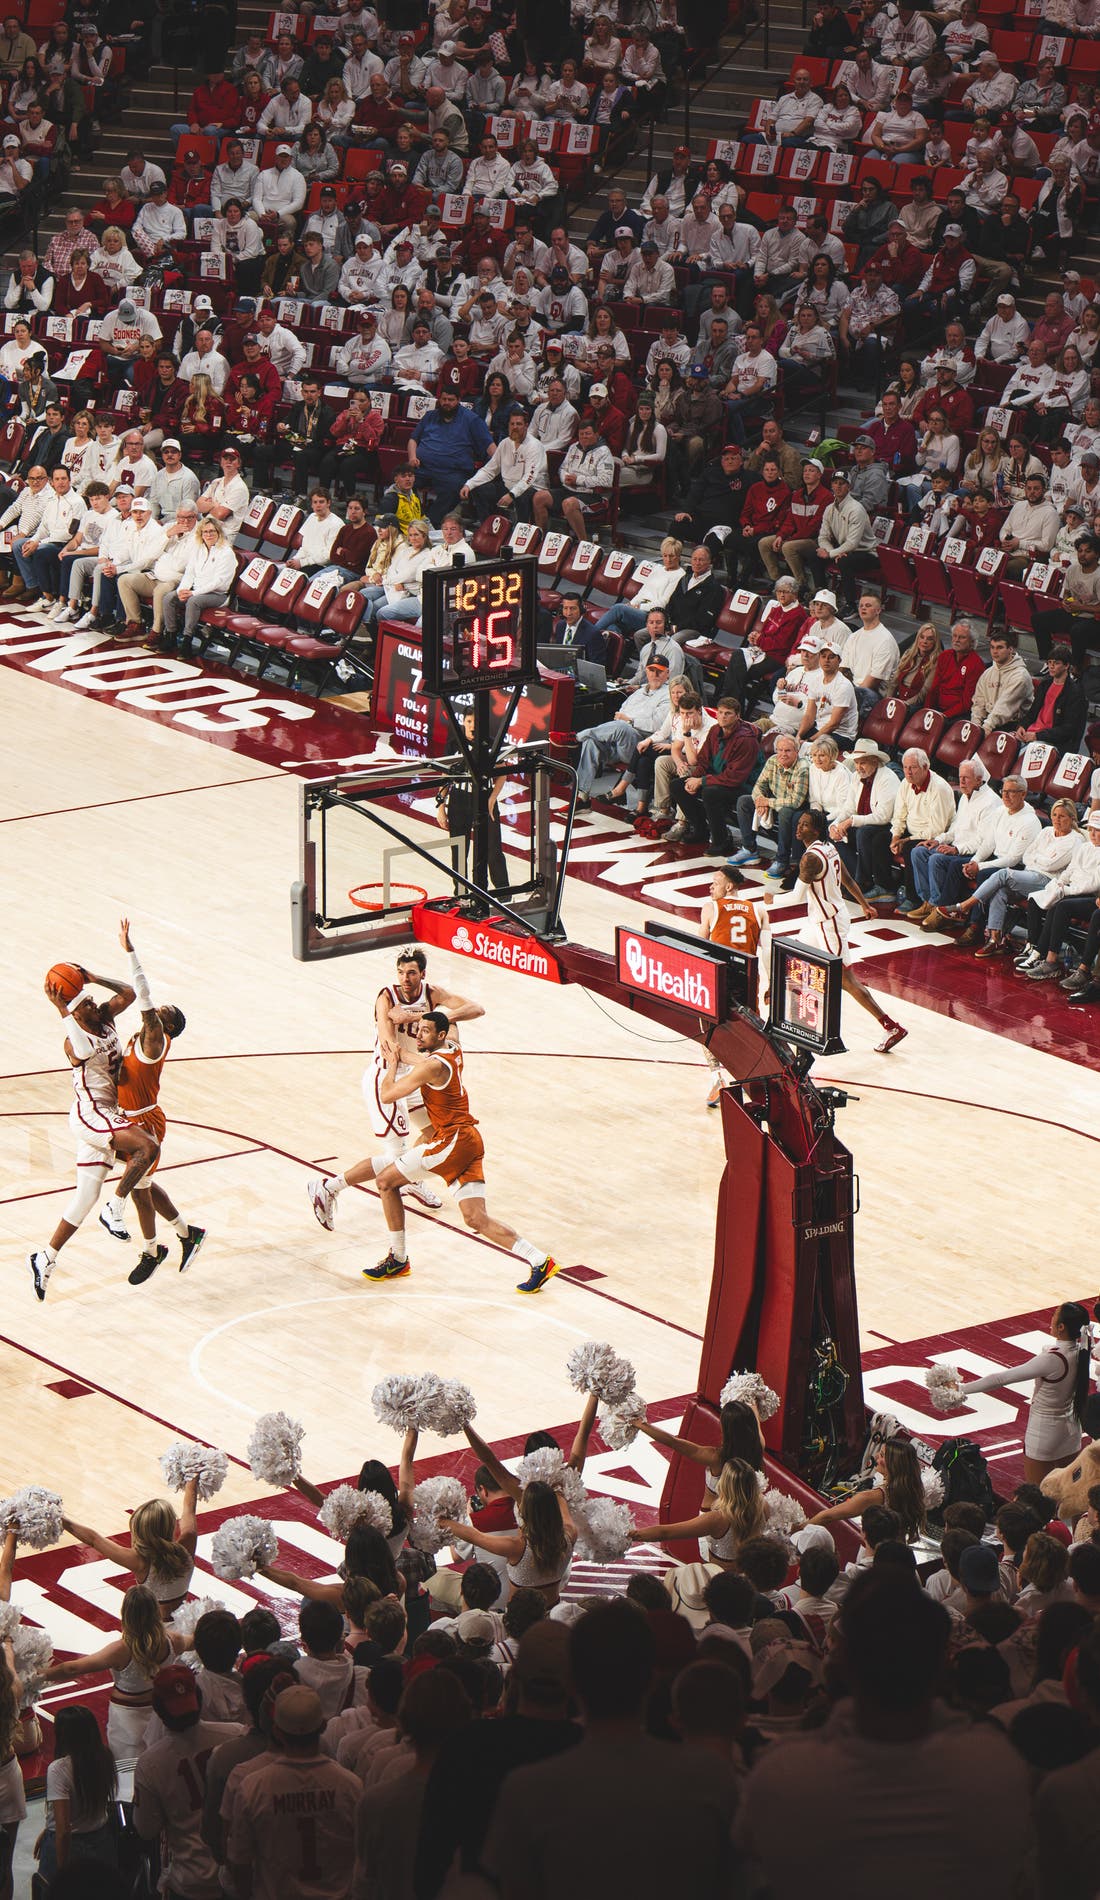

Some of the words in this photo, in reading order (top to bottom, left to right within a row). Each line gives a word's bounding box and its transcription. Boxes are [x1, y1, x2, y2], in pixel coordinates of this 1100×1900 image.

[113, 328, 141, 341] SOONERS
[455, 572, 521, 611] 12:32
[471, 610, 513, 669] 15
[397, 643, 423, 662] OKLAH
[421, 704, 428, 715] 4
[395, 713, 422, 730] FOULS
[422, 723, 429, 734] 2
[722, 902, 750, 914] WEAVER
[729, 916, 748, 944] 2
[625, 937, 647, 984] OU
[648, 957, 711, 1010] Health
[781, 1021, 820, 1042] DAKTRONICS
[804, 1220, 846, 1241] SPALDING
[272, 1789, 336, 1815] MURRAY
[297, 1817, 321, 1880] 1
